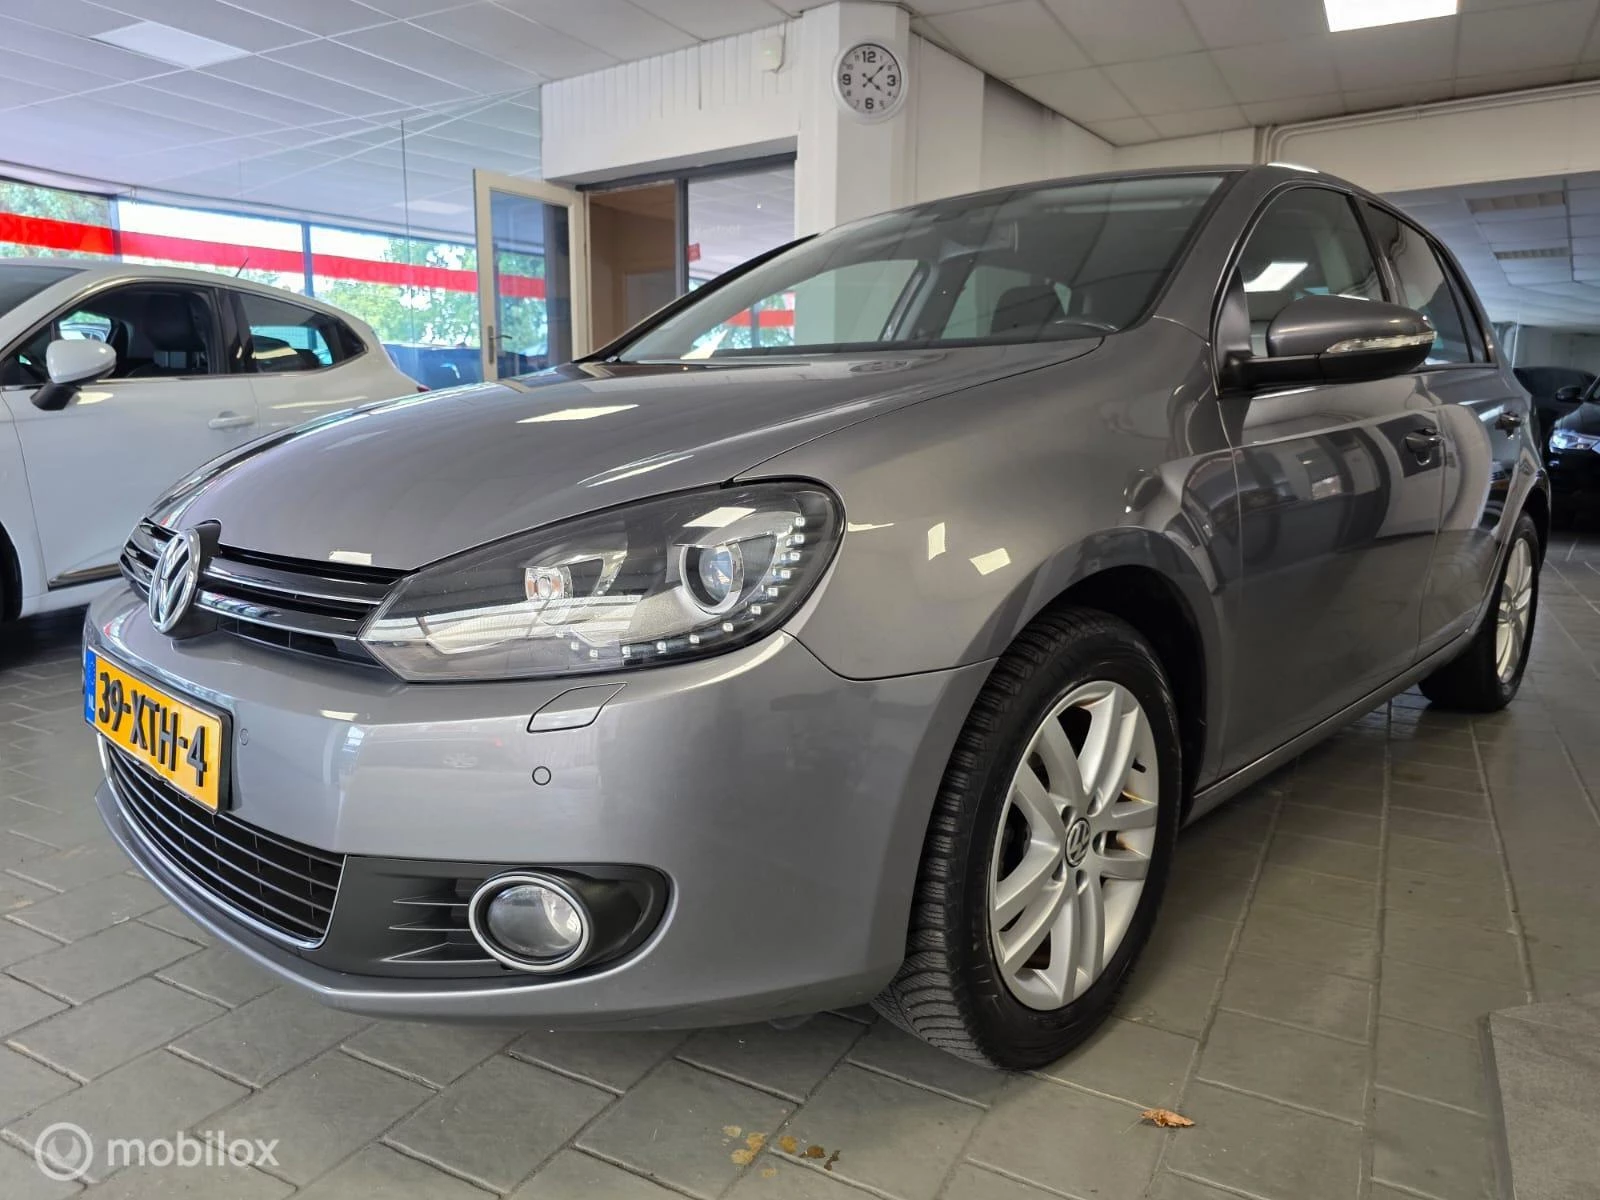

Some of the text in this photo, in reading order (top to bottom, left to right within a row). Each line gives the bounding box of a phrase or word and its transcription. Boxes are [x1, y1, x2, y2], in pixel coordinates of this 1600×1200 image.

[862, 51, 876, 63] 12
[842, 73, 851, 85] 9
[887, 74, 896, 87] 3
[865, 97, 874, 109] 6
[99, 671, 207, 787] 39-XTH-4
